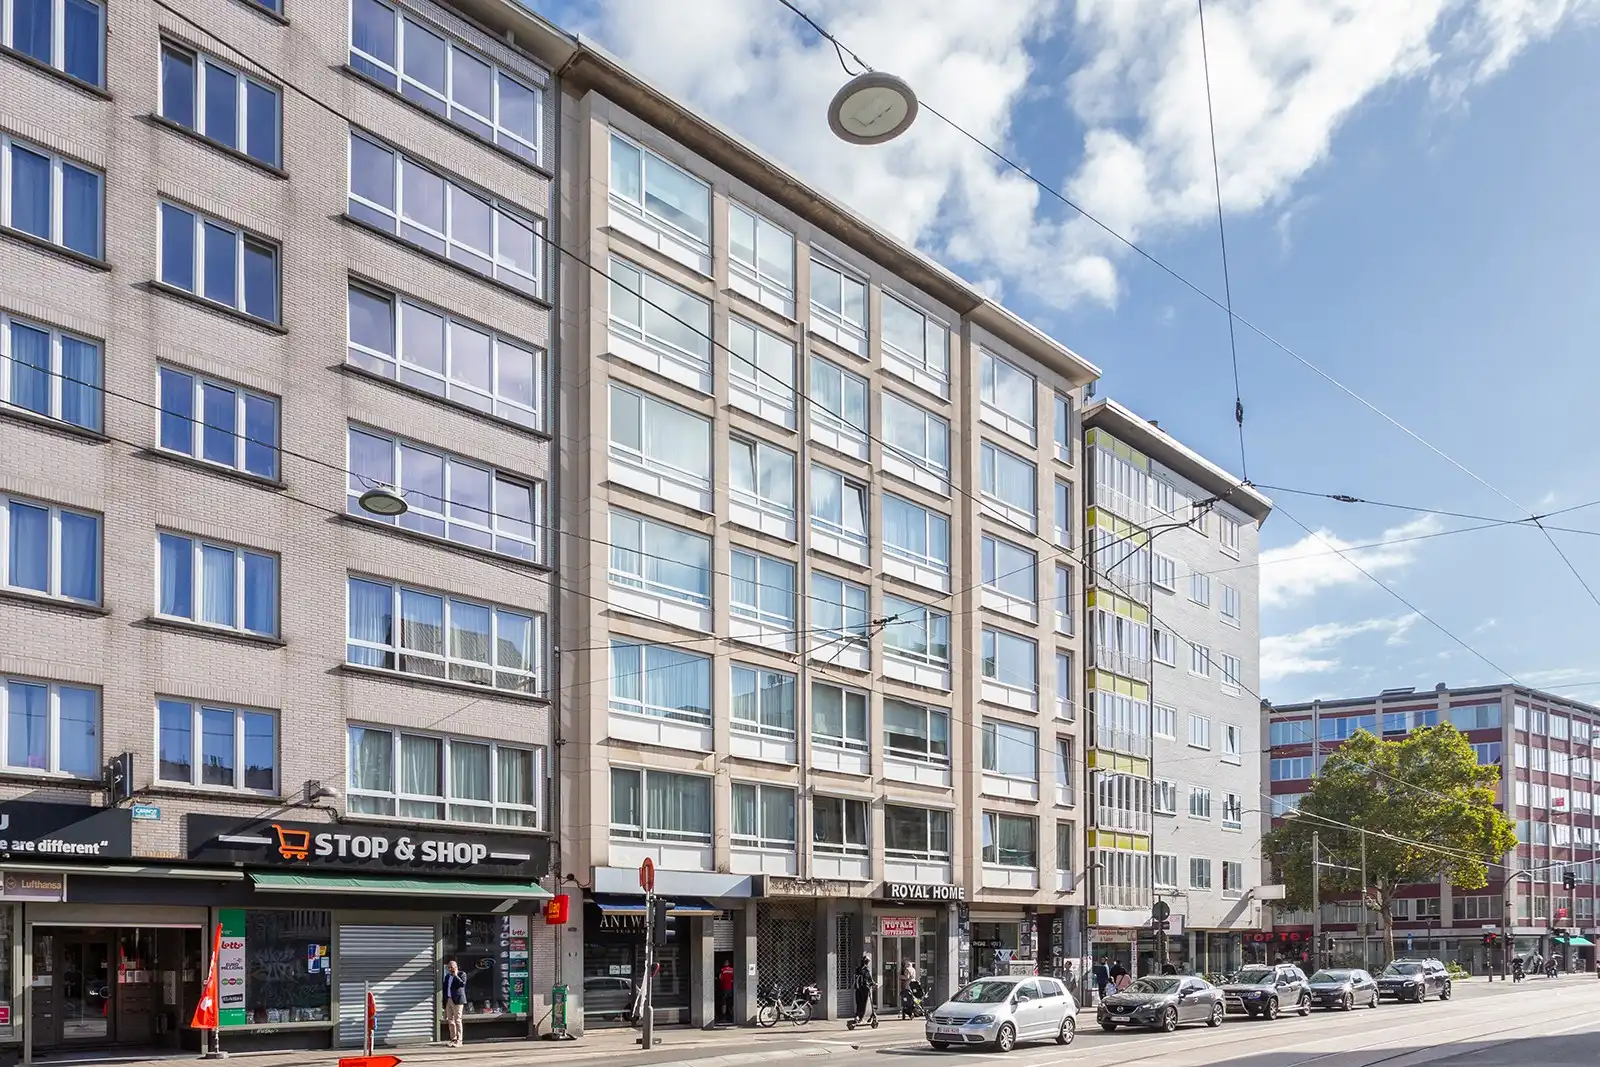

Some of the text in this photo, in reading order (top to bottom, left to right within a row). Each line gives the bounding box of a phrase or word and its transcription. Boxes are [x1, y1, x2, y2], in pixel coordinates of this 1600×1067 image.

[11, 840, 35, 851] are
[315, 833, 487, 865] STOP & SHOP
[21, 880, 62, 890] Lufthansa
[891, 884, 965, 900] ROYAL HOME
[1243, 933, 1274, 941] TOP
